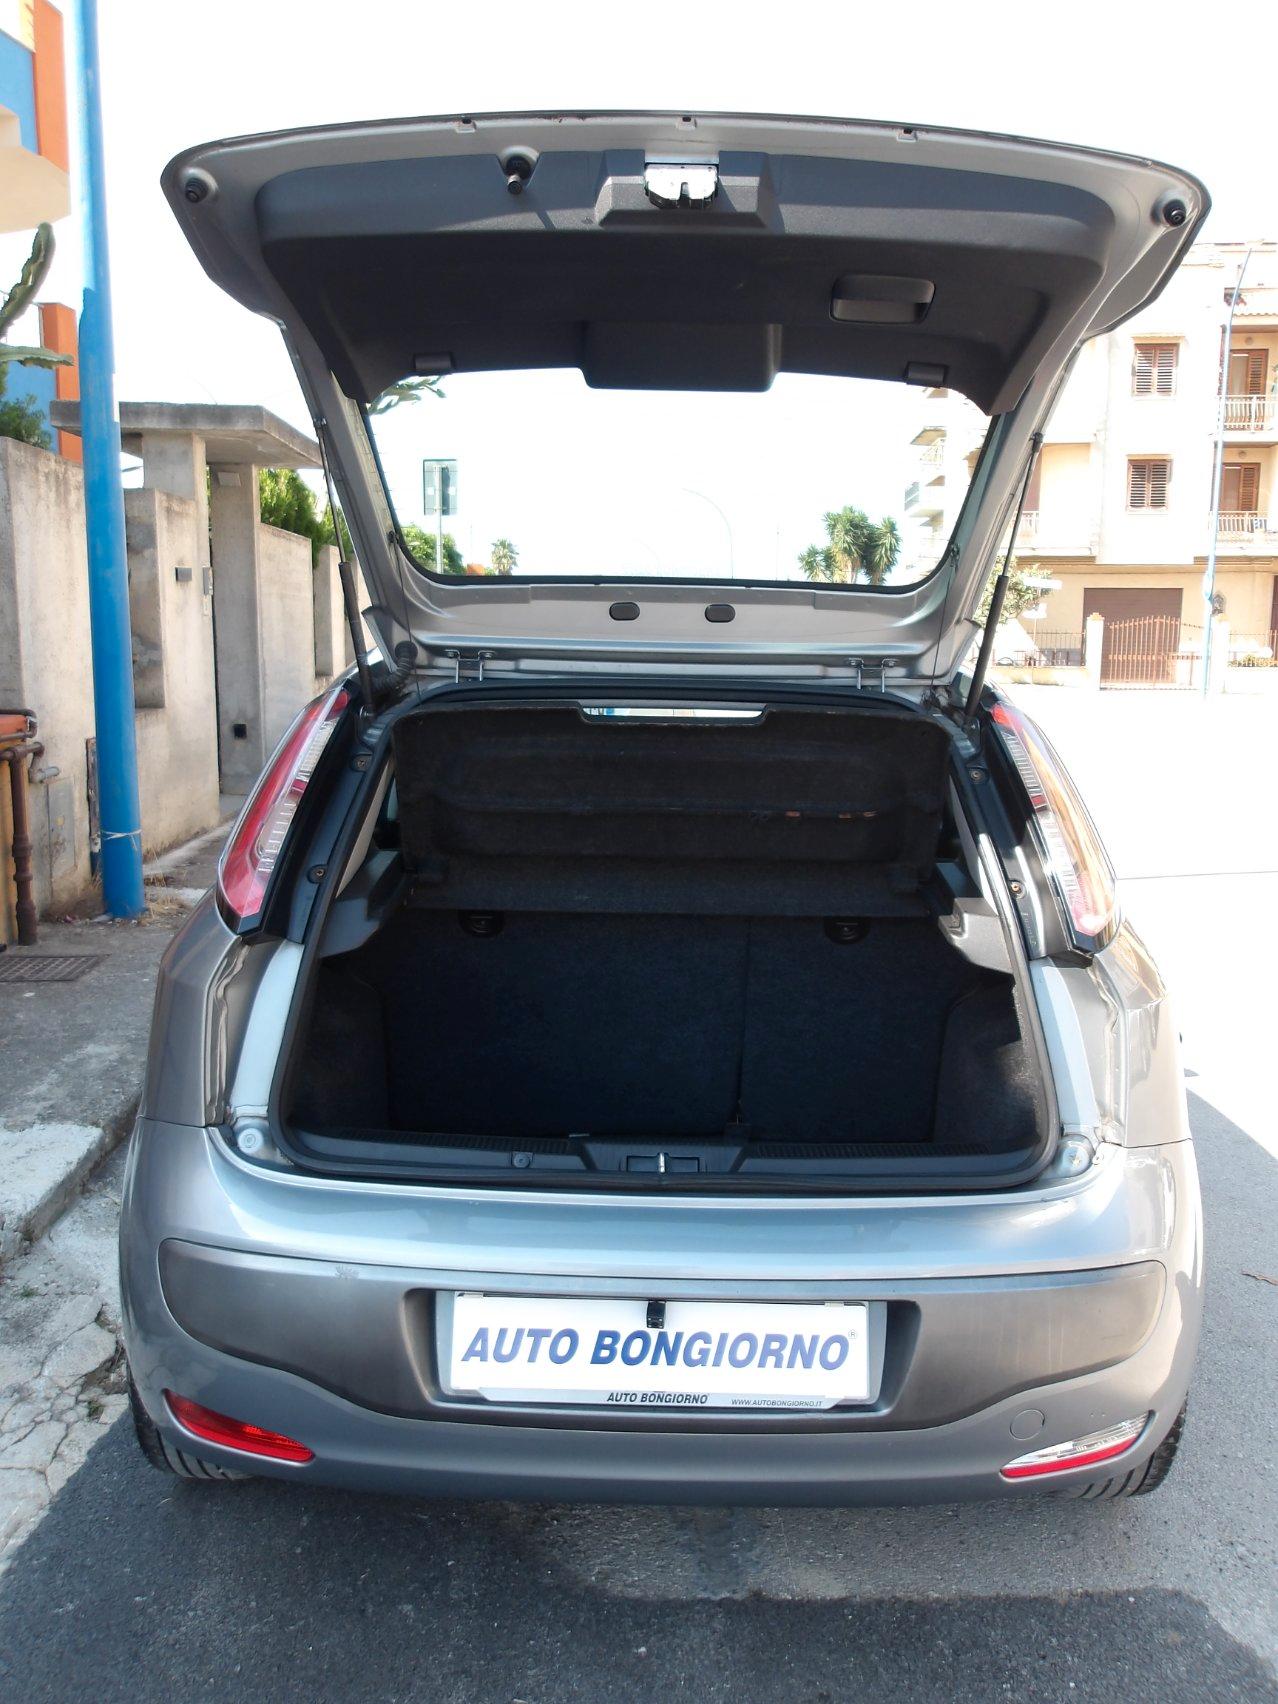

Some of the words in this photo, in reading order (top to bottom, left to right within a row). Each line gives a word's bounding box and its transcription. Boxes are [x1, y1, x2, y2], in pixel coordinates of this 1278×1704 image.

[461, 1327, 579, 1364] AUTO
[590, 1329, 849, 1370] BONGIORNO
[606, 1392, 637, 1403] AUTO
[640, 1393, 708, 1405] BONGIORNO
[731, 1398, 823, 1408] WWW.AUTOBONGIORNO.IT
